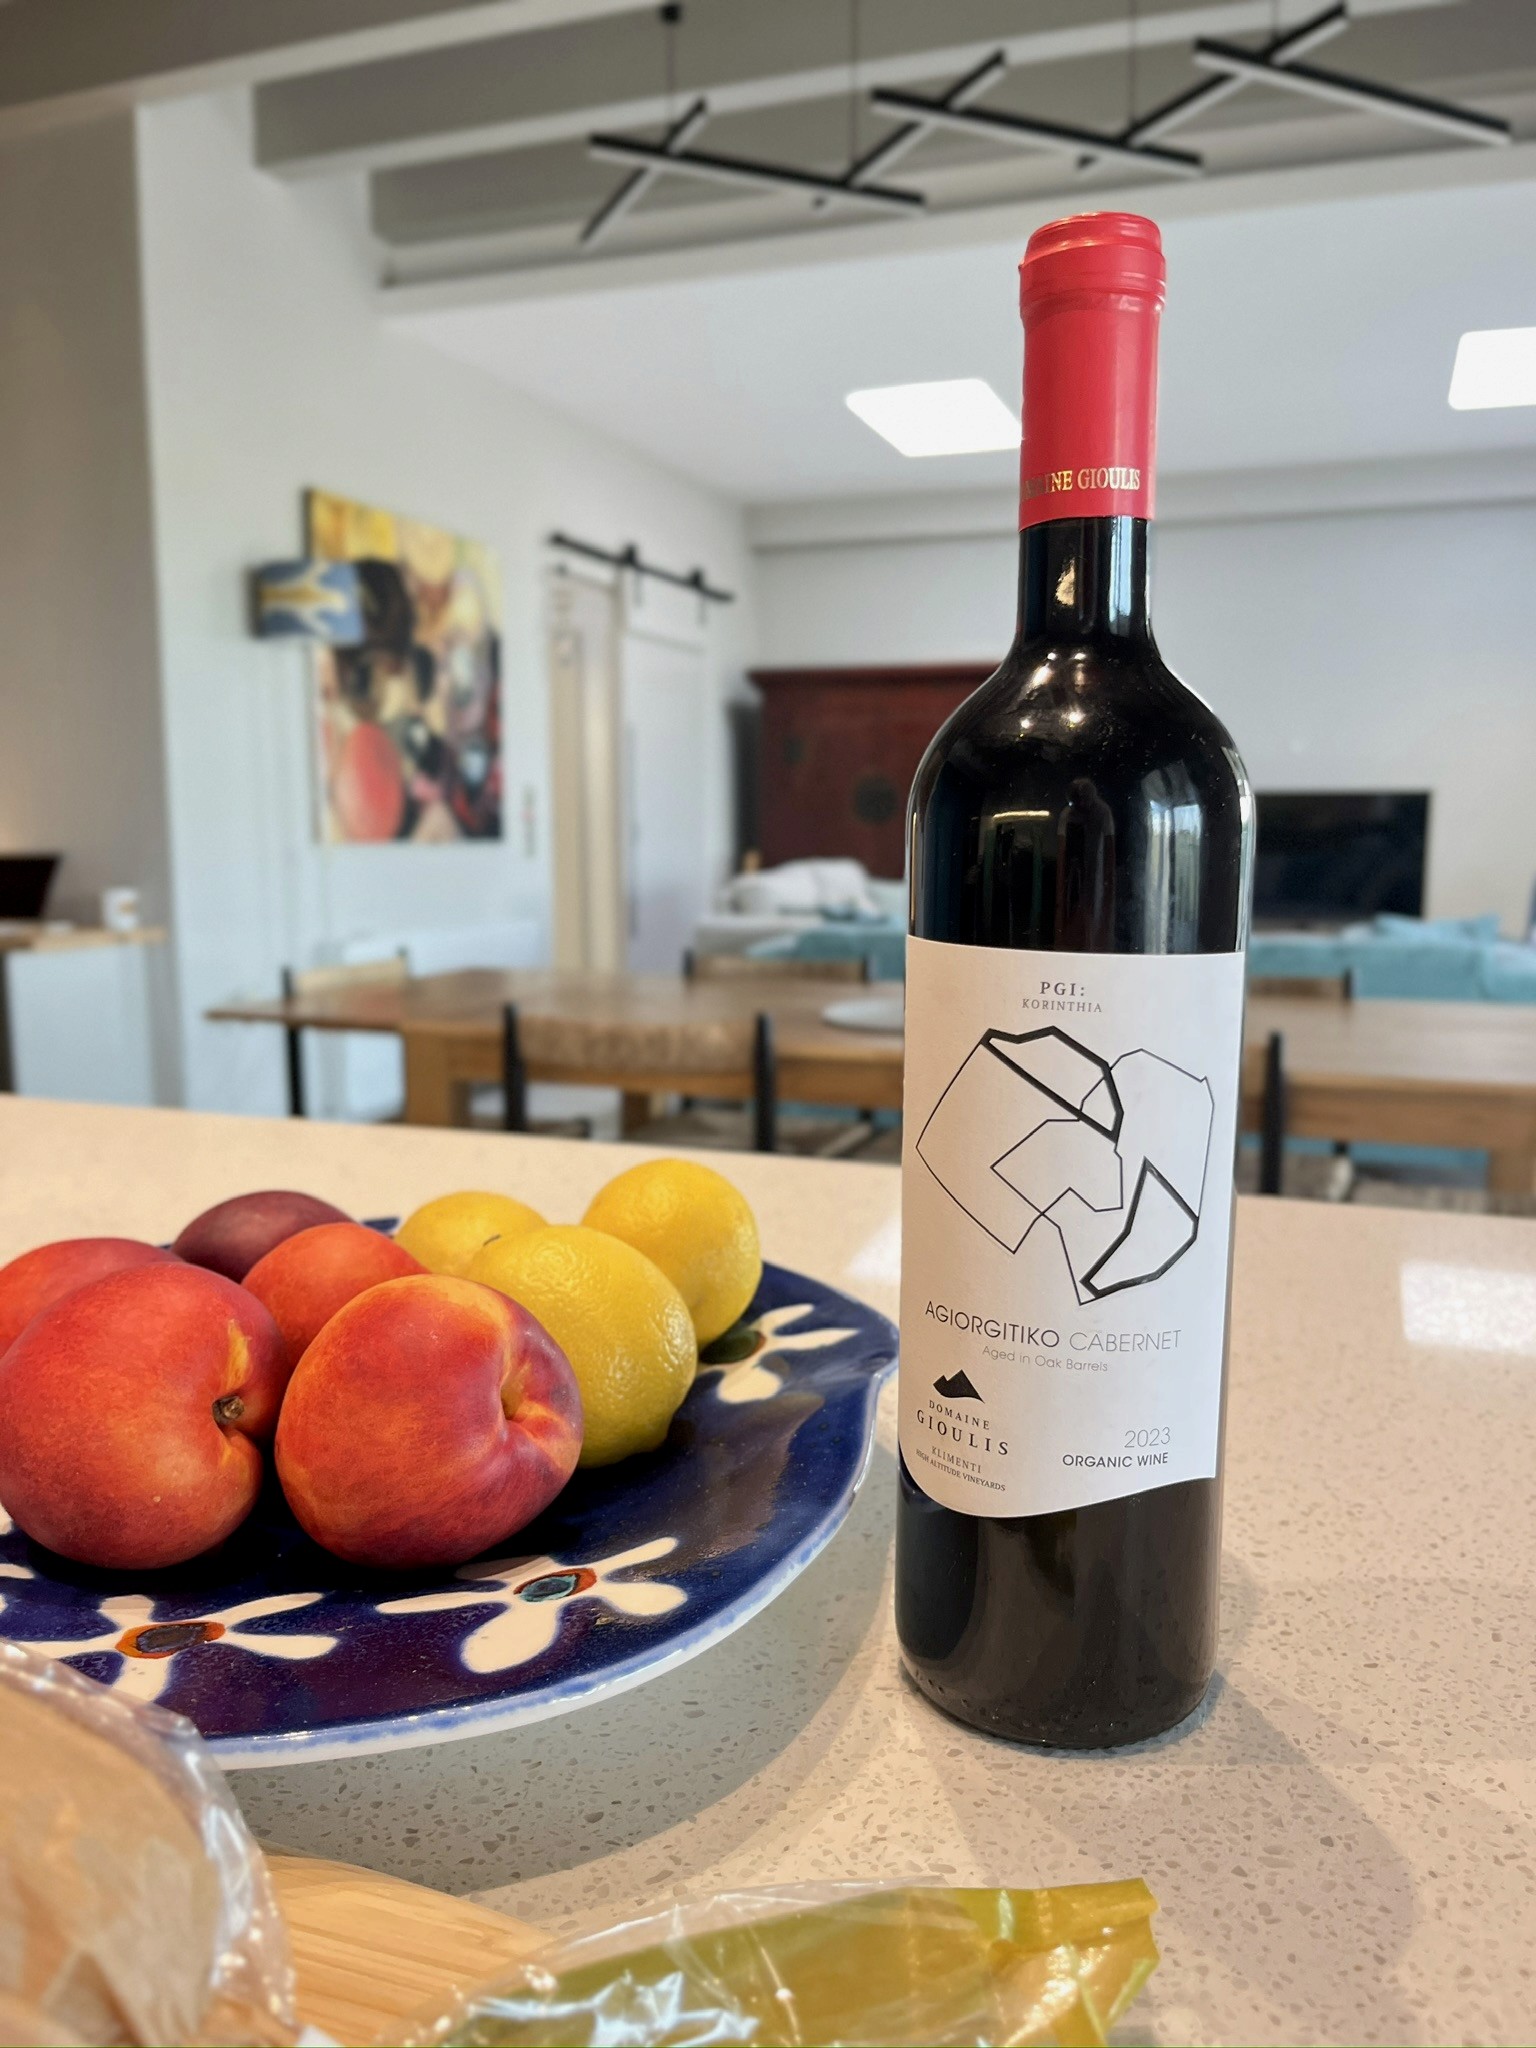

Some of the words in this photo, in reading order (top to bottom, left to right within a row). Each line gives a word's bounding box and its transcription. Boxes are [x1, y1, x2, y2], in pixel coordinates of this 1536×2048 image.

[1077, 467, 1141, 491] GIOULIS
[1039, 981, 1087, 997] PGI:
[1021, 998, 1102, 1013] KORINTHIA
[925, 1301, 1060, 1348] AGIORGITIKO
[1069, 1330, 1182, 1352] CABERNET
[982, 1345, 1015, 1363] Aged
[1019, 1354, 1031, 1365] in
[1034, 1355, 1062, 1369] Oak
[1066, 1358, 1108, 1372] Barrels
[928, 1400, 990, 1430] DOMAINE
[916, 1409, 1009, 1455] GIOULIS
[1124, 1426, 1171, 1448] 2023
[915, 1449, 930, 1463] HIGH
[929, 1458, 961, 1478] ALTITUDE
[962, 1472, 1006, 1492] VINEYARDS
[931, 1445, 982, 1474] KLIMENTI
[1062, 1454, 1133, 1468] ORGANIC
[1137, 1452, 1169, 1466] WINE
